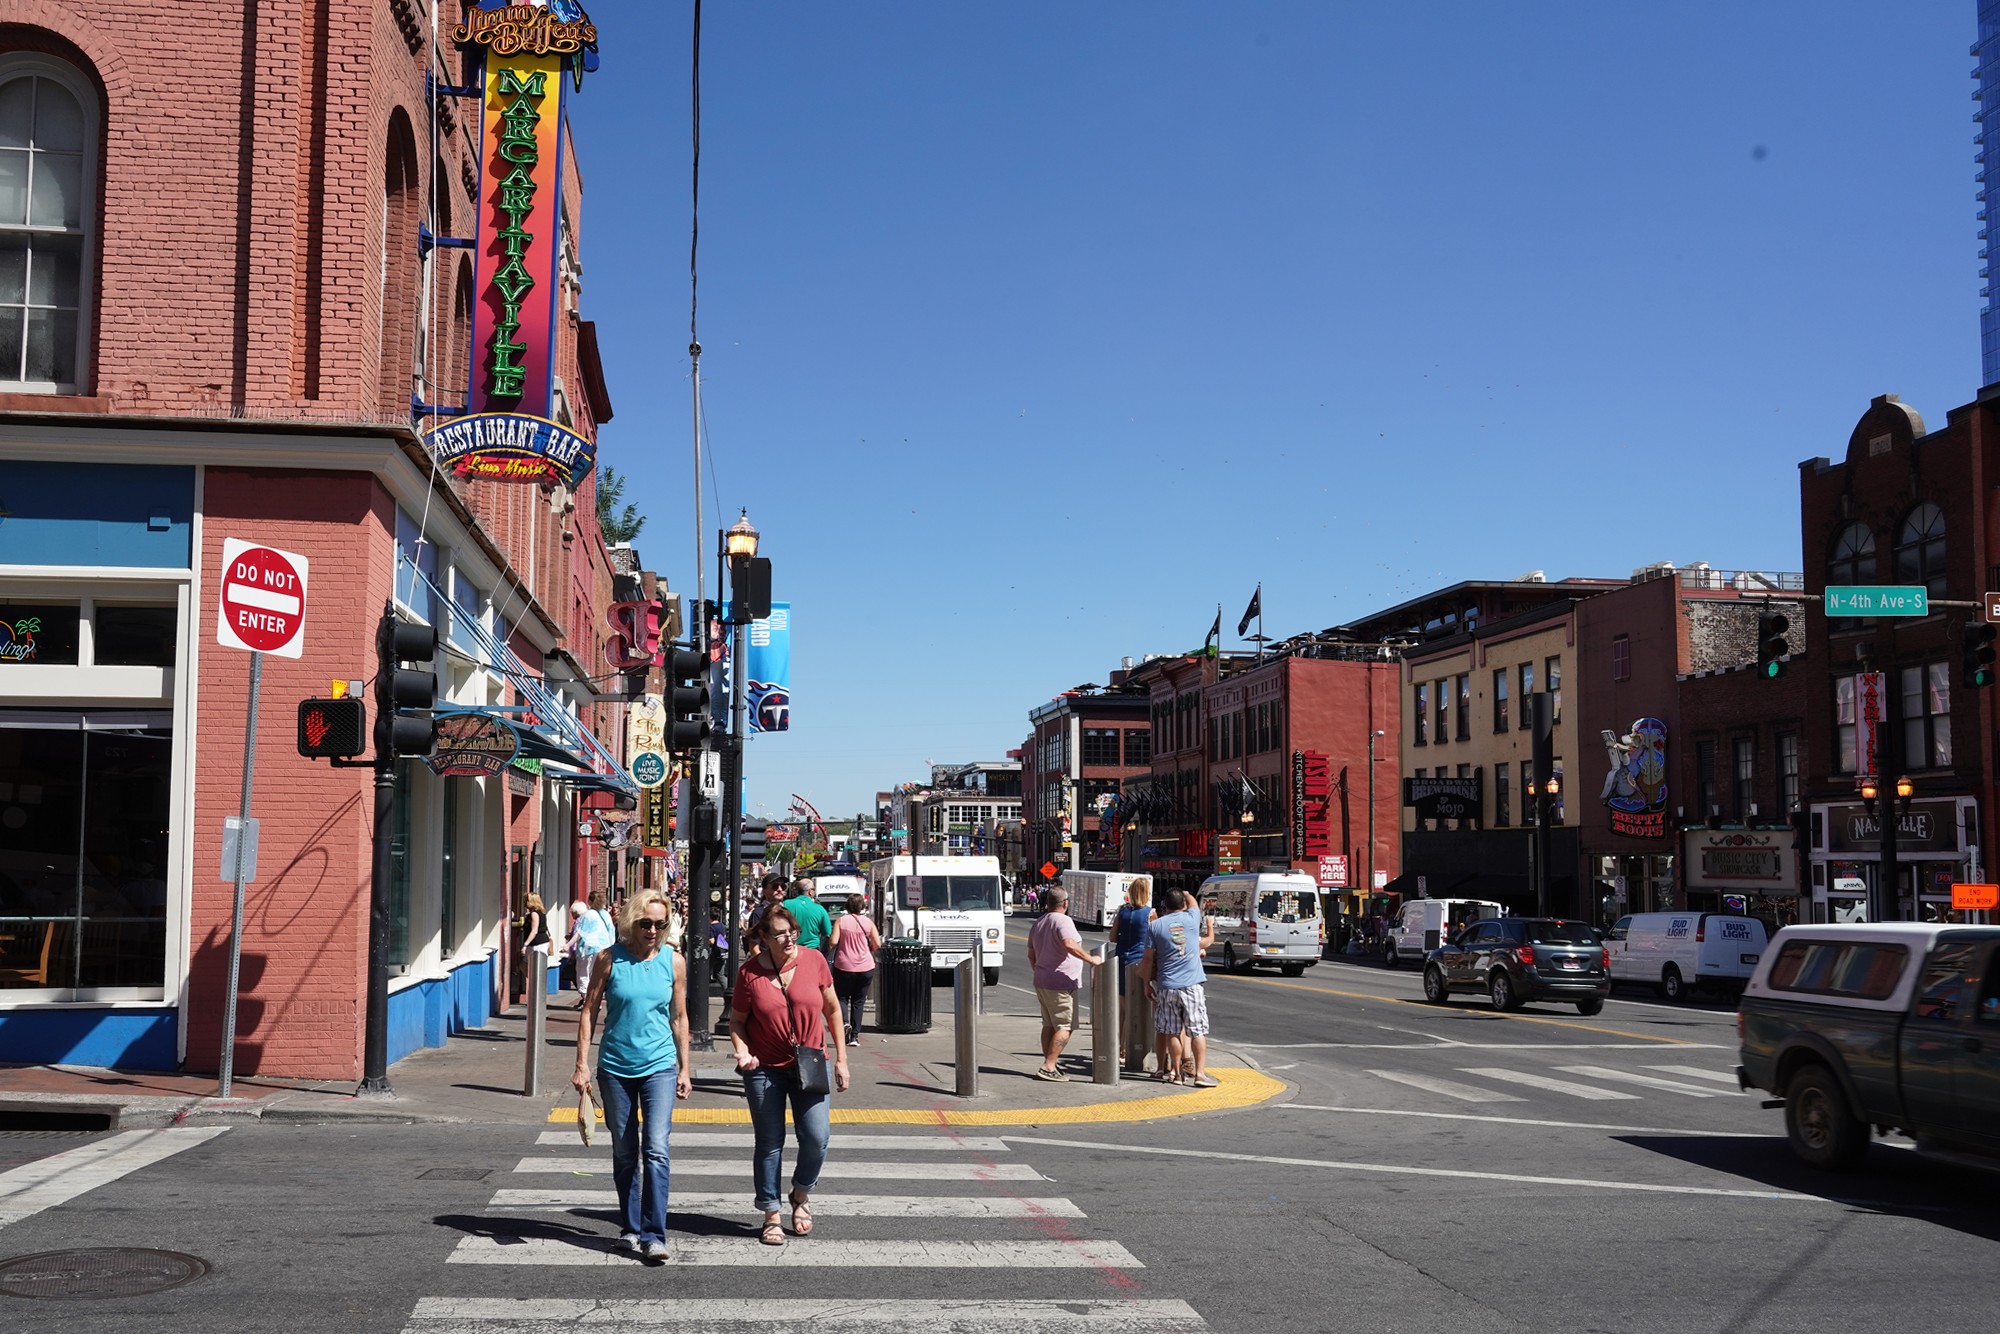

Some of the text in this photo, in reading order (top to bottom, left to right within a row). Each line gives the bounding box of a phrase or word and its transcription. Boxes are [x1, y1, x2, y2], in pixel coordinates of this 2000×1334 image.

[451, 5, 548, 43] Jimmy
[492, 68, 548, 397] MARGARITAVILLE
[434, 418, 582, 464] RESTAURANT BAR
[502, 459, 548, 475] Music
[236, 562, 295, 590] DO NOT
[238, 609, 286, 634] ENTER
[771, 608, 788, 631] KEVIN
[434, 754, 482, 769] RESTAURANT
[483, 758, 501, 771] BAR
[1295, 749, 1304, 788] KITCHEN
[1304, 749, 1330, 796] JASON
[1412, 785, 1478, 801] BREWHOUSE
[1296, 794, 1304, 835] ROOFTOP
[1436, 804, 1464, 817] MOJO
[1612, 810, 1665, 825] BETTY
[1612, 821, 1664, 837] BOOTS
[1712, 852, 1768, 864] MUSIC CITY
[1320, 864, 1346, 872] PARK
[1320, 872, 1346, 880] HERE
[1671, 919, 1688, 928] BUD
[1725, 922, 1746, 931] BUD
[1667, 928, 1688, 937] LIGHT
[1722, 930, 1750, 939] LIGHT
